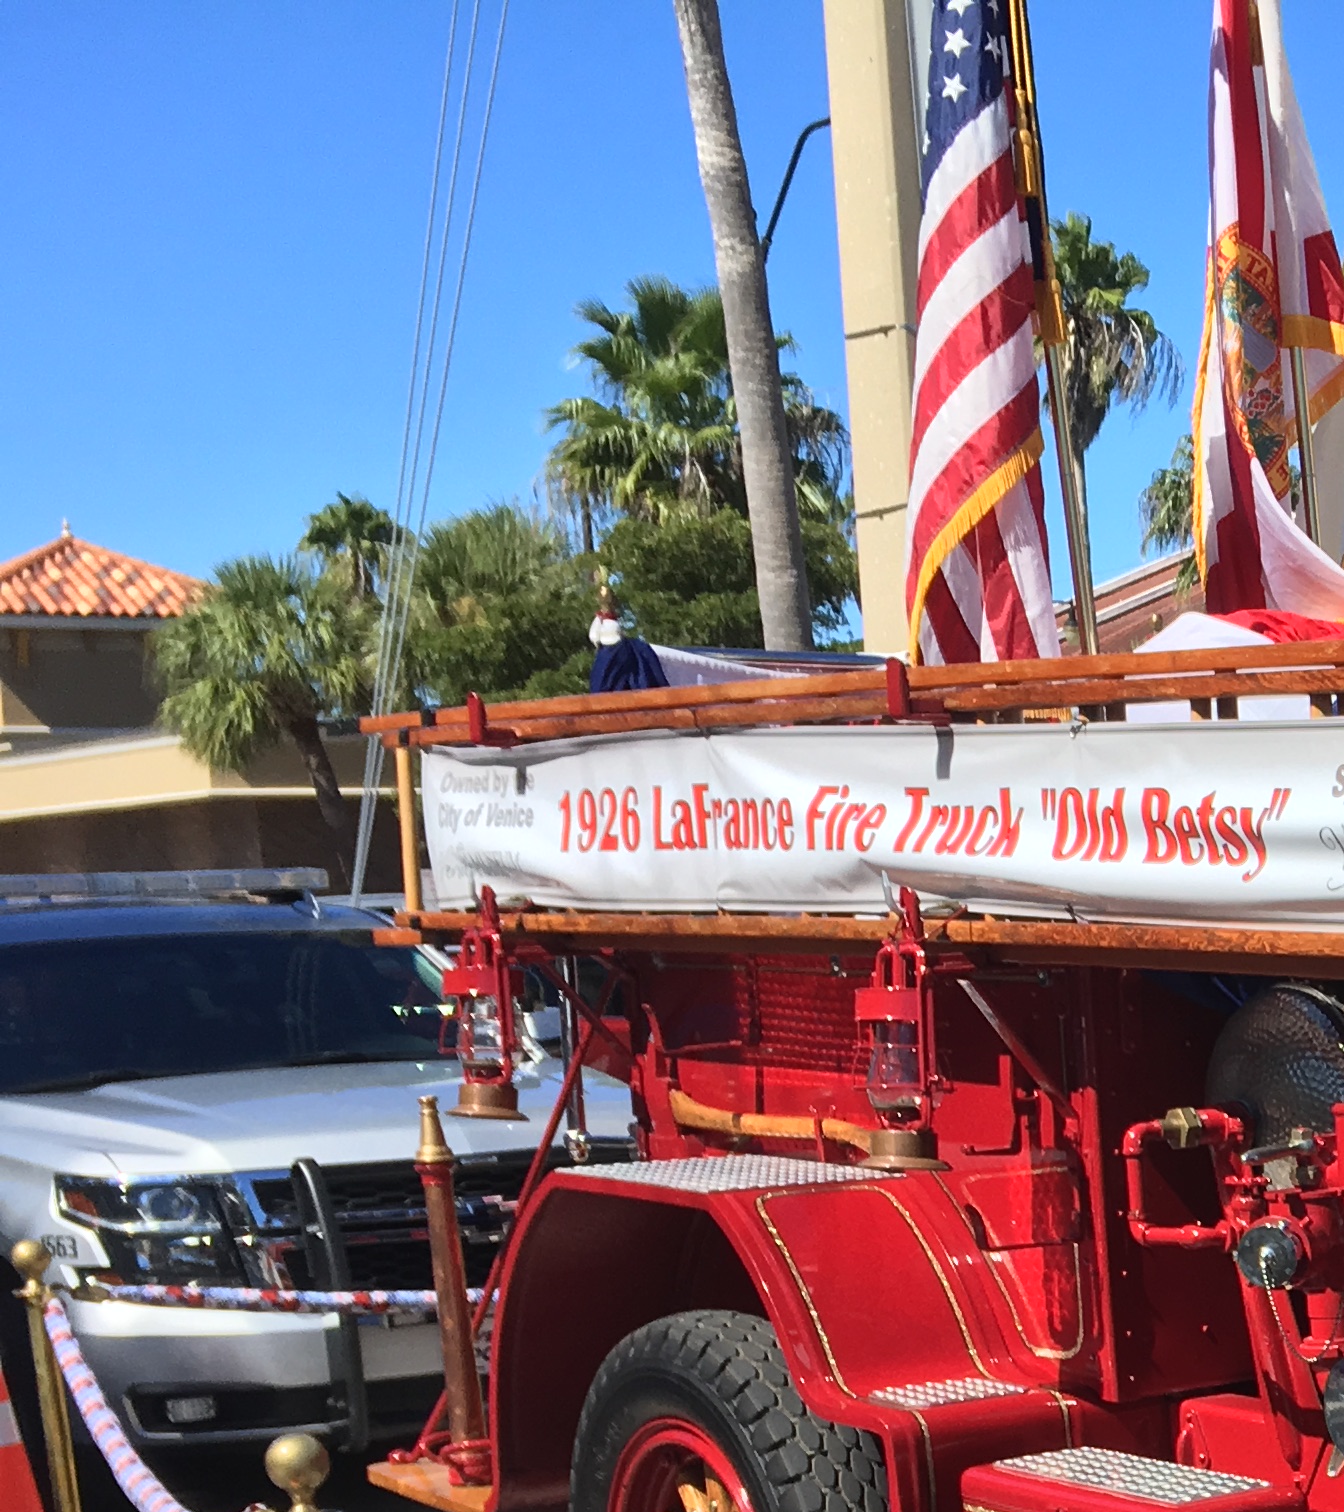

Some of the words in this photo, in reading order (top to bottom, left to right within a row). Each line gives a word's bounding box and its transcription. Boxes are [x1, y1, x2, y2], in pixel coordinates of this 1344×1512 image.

[439, 768, 491, 795] Owned
[492, 769, 509, 798] by
[437, 802, 462, 834] City
[463, 802, 484, 828] of
[485, 801, 535, 829] Venice
[557, 785, 642, 854] 1926
[652, 782, 796, 852] LaFrance
[806, 784, 888, 853] Fire
[892, 786, 1025, 858] Truck
[1040, 786, 1129, 863] "Old
[1140, 786, 1292, 884] Betsy"
